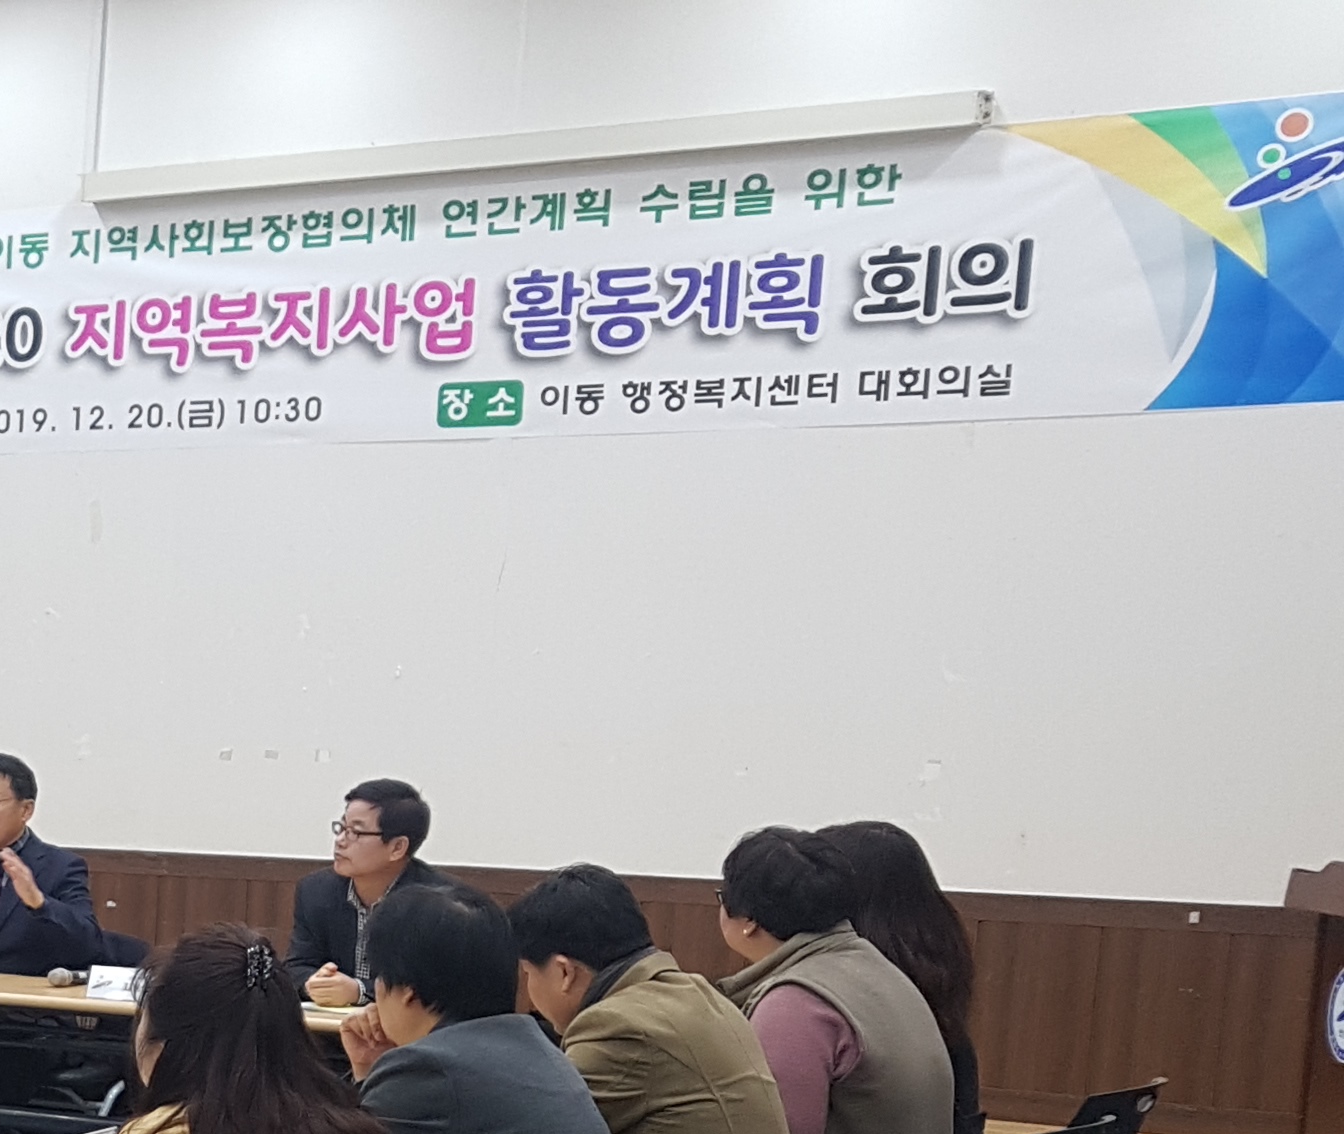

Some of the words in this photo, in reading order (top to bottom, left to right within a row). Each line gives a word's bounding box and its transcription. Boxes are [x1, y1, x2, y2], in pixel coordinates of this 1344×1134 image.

[69, 201, 418, 265] 지역사회보장협의체
[443, 188, 613, 240] 연간계획
[640, 172, 775, 223] 수립을
[805, 162, 903, 209] 위한
[67, 276, 478, 368] 지역복지사업
[509, 251, 826, 355] 활동계획
[859, 237, 1036, 318] 회의
[72, 405, 114, 432] 12.
[238, 396, 323, 424] 10:30
[540, 381, 606, 416] 이동
[622, 371, 840, 411] 행정복지센터
[859, 363, 1015, 402] 대회의실
